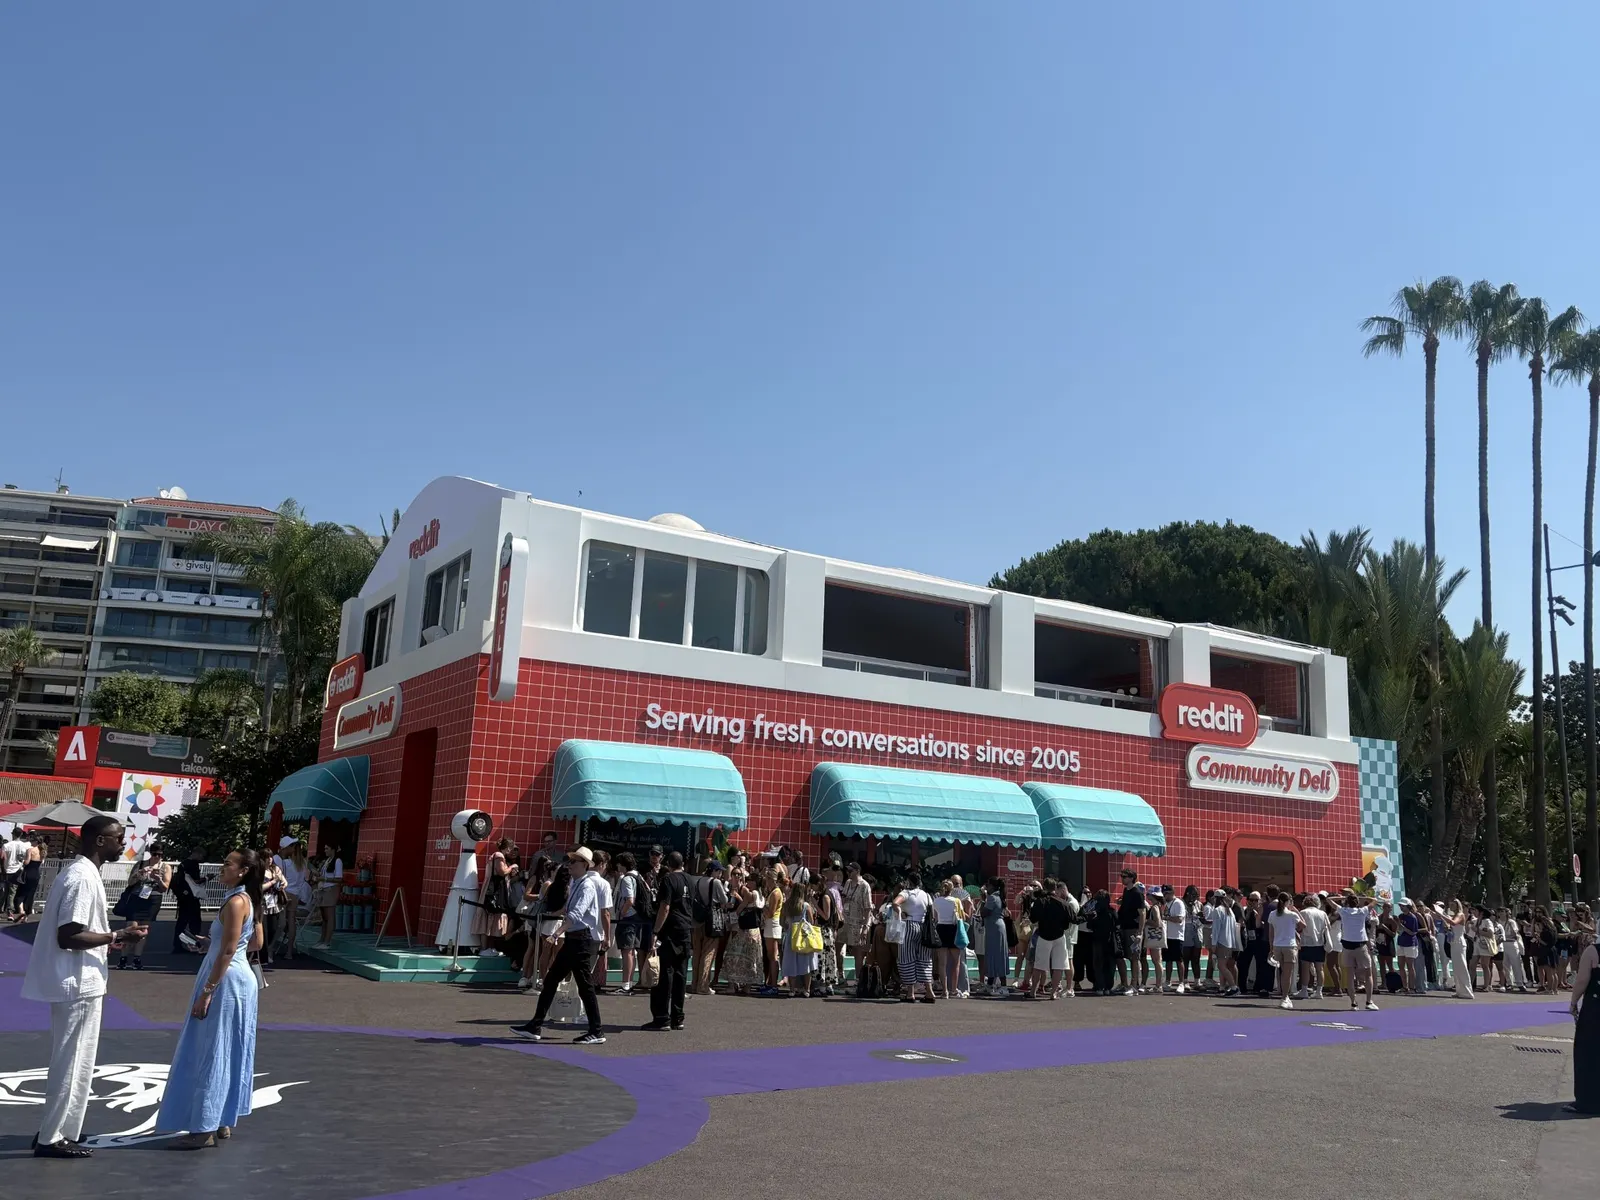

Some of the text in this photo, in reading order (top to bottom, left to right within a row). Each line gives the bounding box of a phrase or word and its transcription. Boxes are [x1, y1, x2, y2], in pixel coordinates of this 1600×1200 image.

[188, 520, 216, 532] DAY
[409, 518, 441, 560] reddit
[185, 560, 212, 572] givsly
[495, 581, 508, 679] DELI
[336, 665, 356, 695] reddit
[338, 695, 395, 738] Community Deli
[1178, 701, 1244, 734] reddit
[645, 702, 1081, 773] Serving fresh conversations since 2005
[193, 753, 204, 764] to
[1196, 755, 1331, 793] Community Deli
